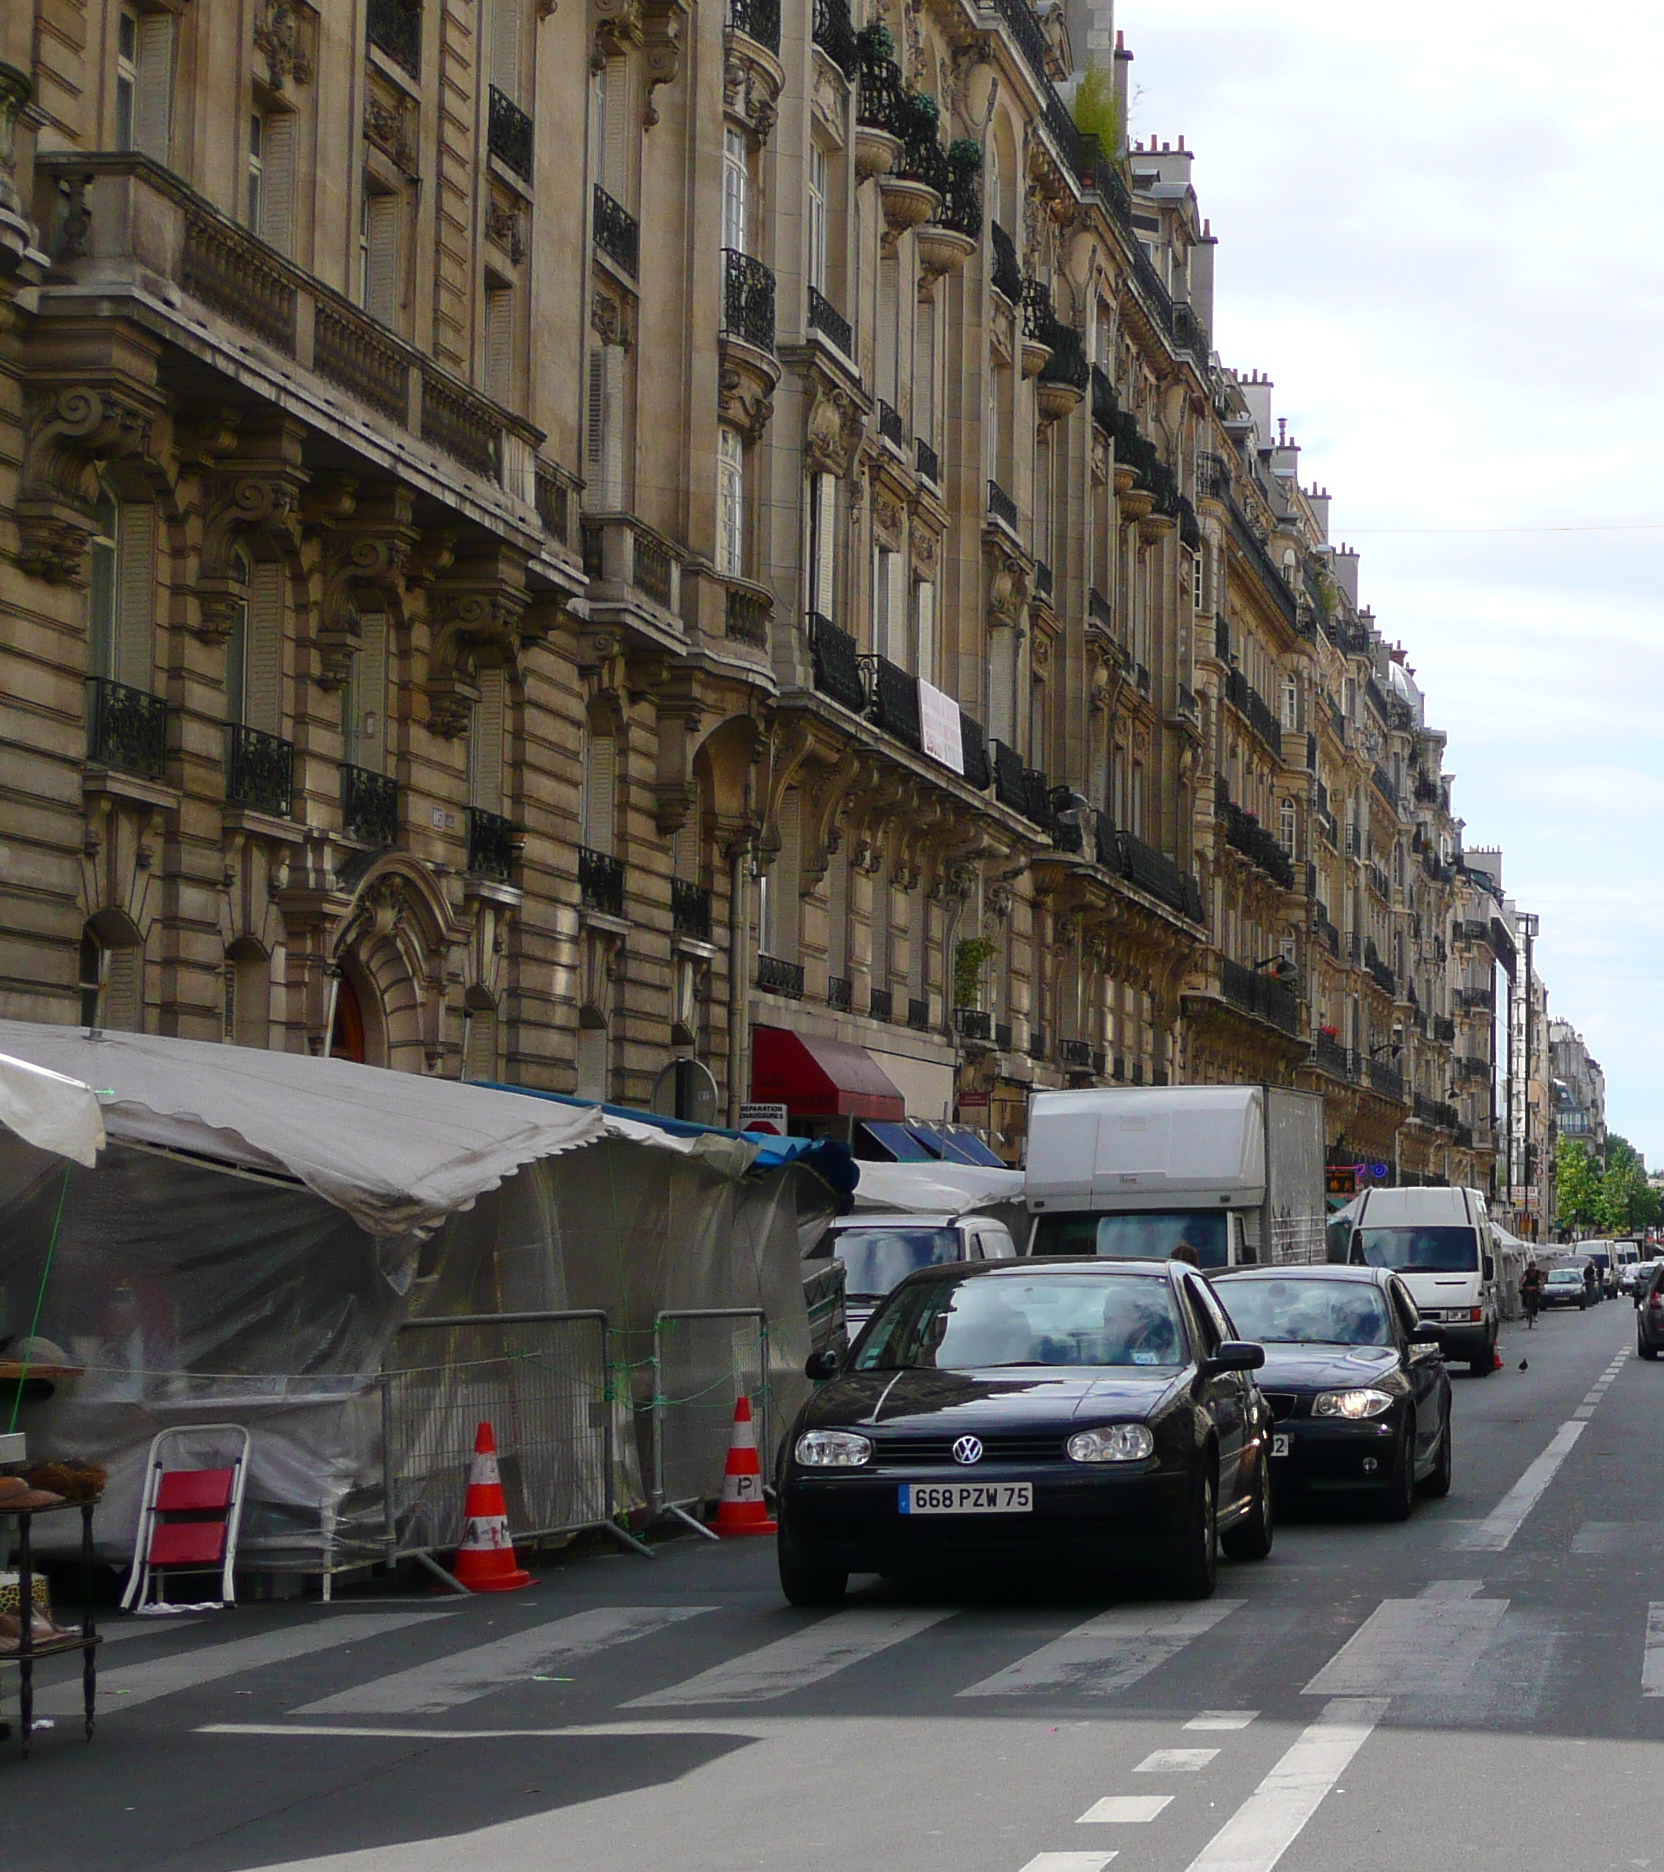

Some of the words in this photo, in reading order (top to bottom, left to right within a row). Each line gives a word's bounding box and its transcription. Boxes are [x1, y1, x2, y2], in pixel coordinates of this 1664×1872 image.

[737, 1476, 752, 1496] P
[915, 1489, 954, 1508] 668
[959, 1488, 998, 1508] PZW
[1003, 1487, 1029, 1507] 75
